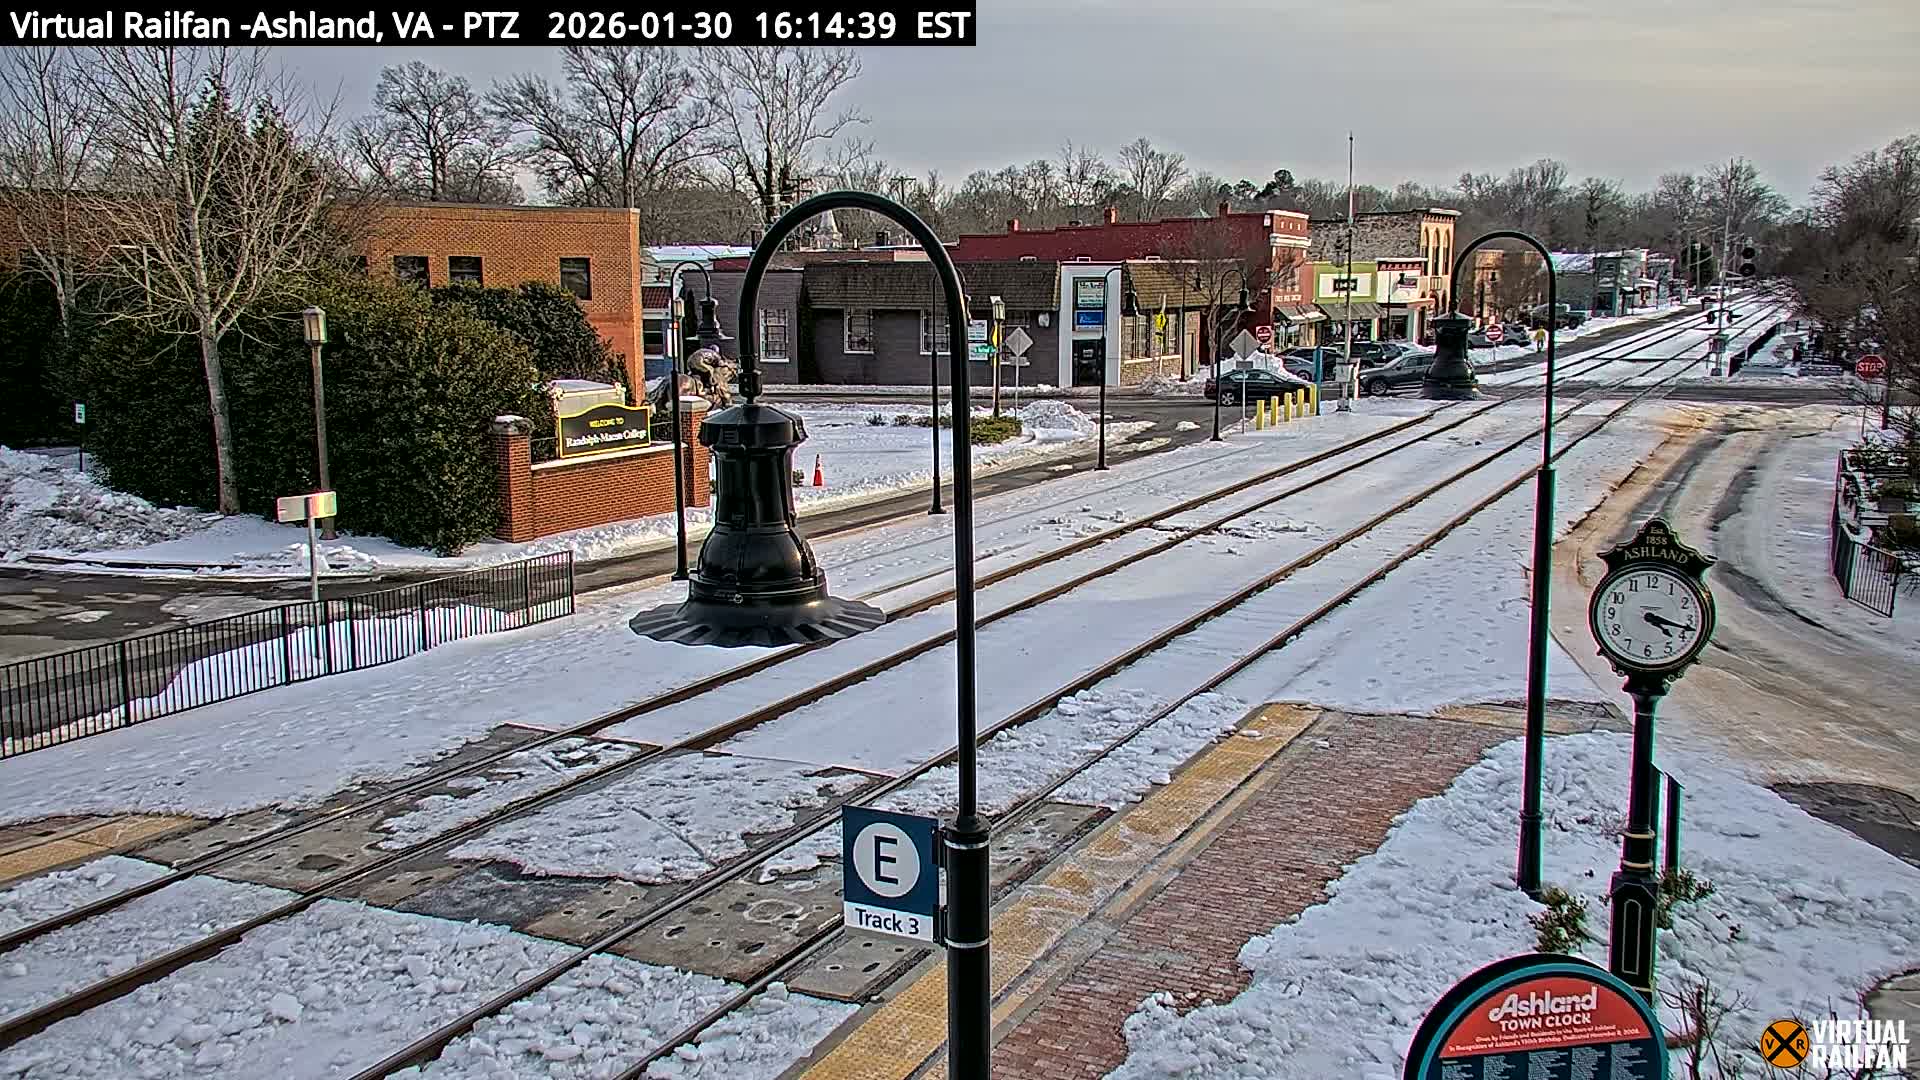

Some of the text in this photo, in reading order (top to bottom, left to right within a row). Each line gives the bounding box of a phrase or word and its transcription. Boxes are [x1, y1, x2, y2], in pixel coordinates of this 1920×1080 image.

[1857, 361, 1883, 372] STOP
[1646, 536, 1668, 545] 1858
[1624, 547, 1689, 564] ASHLAND
[1629, 579, 1639, 592] 11
[1648, 576, 1659, 589] 12
[1669, 583, 1674, 596] 1
[1612, 592, 1625, 605] 10
[1681, 597, 1690, 609] 2
[1608, 607, 1616, 620] 9
[1612, 624, 1621, 636] 8
[1679, 630, 1688, 642] 4
[1624, 638, 1632, 650] 7
[1664, 641, 1673, 654] 5
[1644, 645, 1652, 657] 6
[874, 835, 899, 886] E
[855, 908, 920, 935] Track 3
[1488, 986, 1598, 1021] Ashland
[1500, 1013, 1592, 1031] TOWN CLOCK
